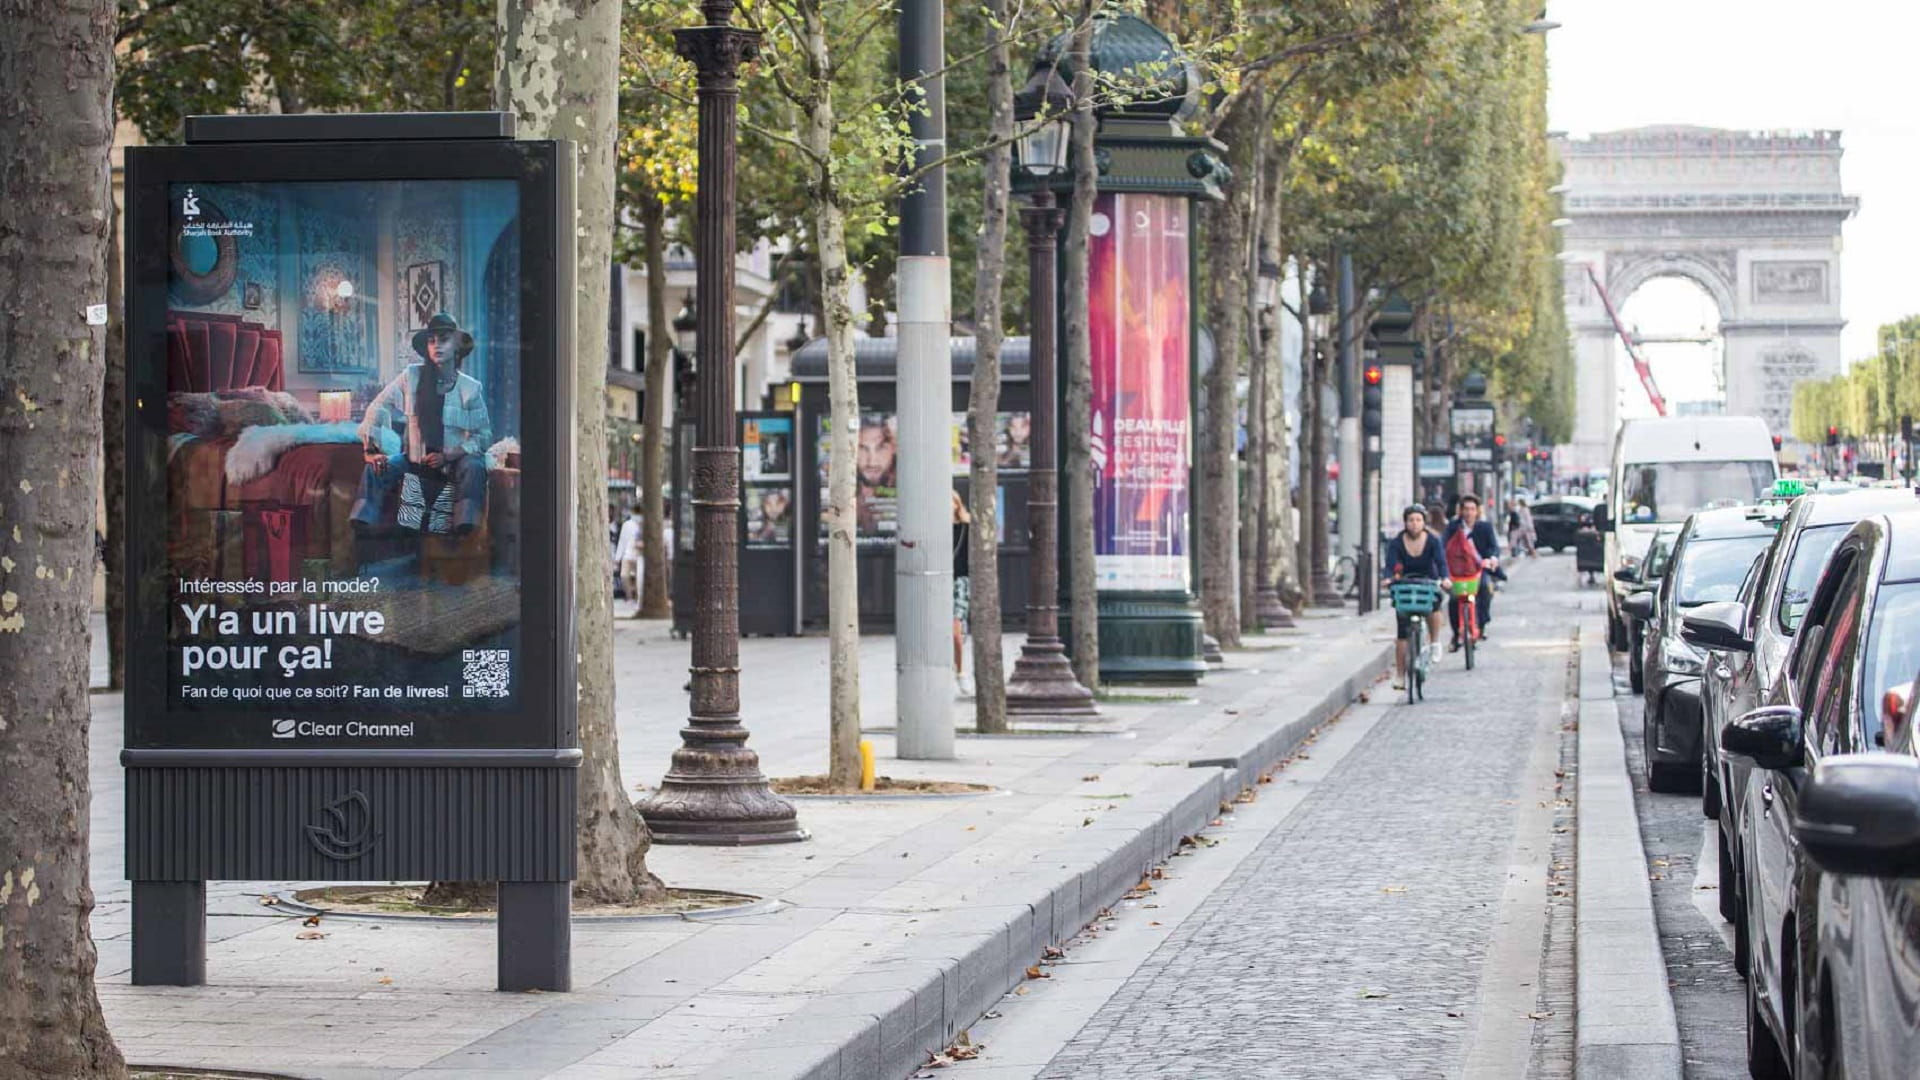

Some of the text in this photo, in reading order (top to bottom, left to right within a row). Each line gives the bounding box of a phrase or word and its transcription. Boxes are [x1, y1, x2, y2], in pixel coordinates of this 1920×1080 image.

[180, 577, 379, 596] Intéressés par la mode?
[181, 603, 385, 635] Y'a un livre
[182, 638, 332, 677] pour ça!
[182, 685, 449, 700] Fan de quoi que ce soit? Fan de livres!
[298, 720, 414, 737] Clear Channel
